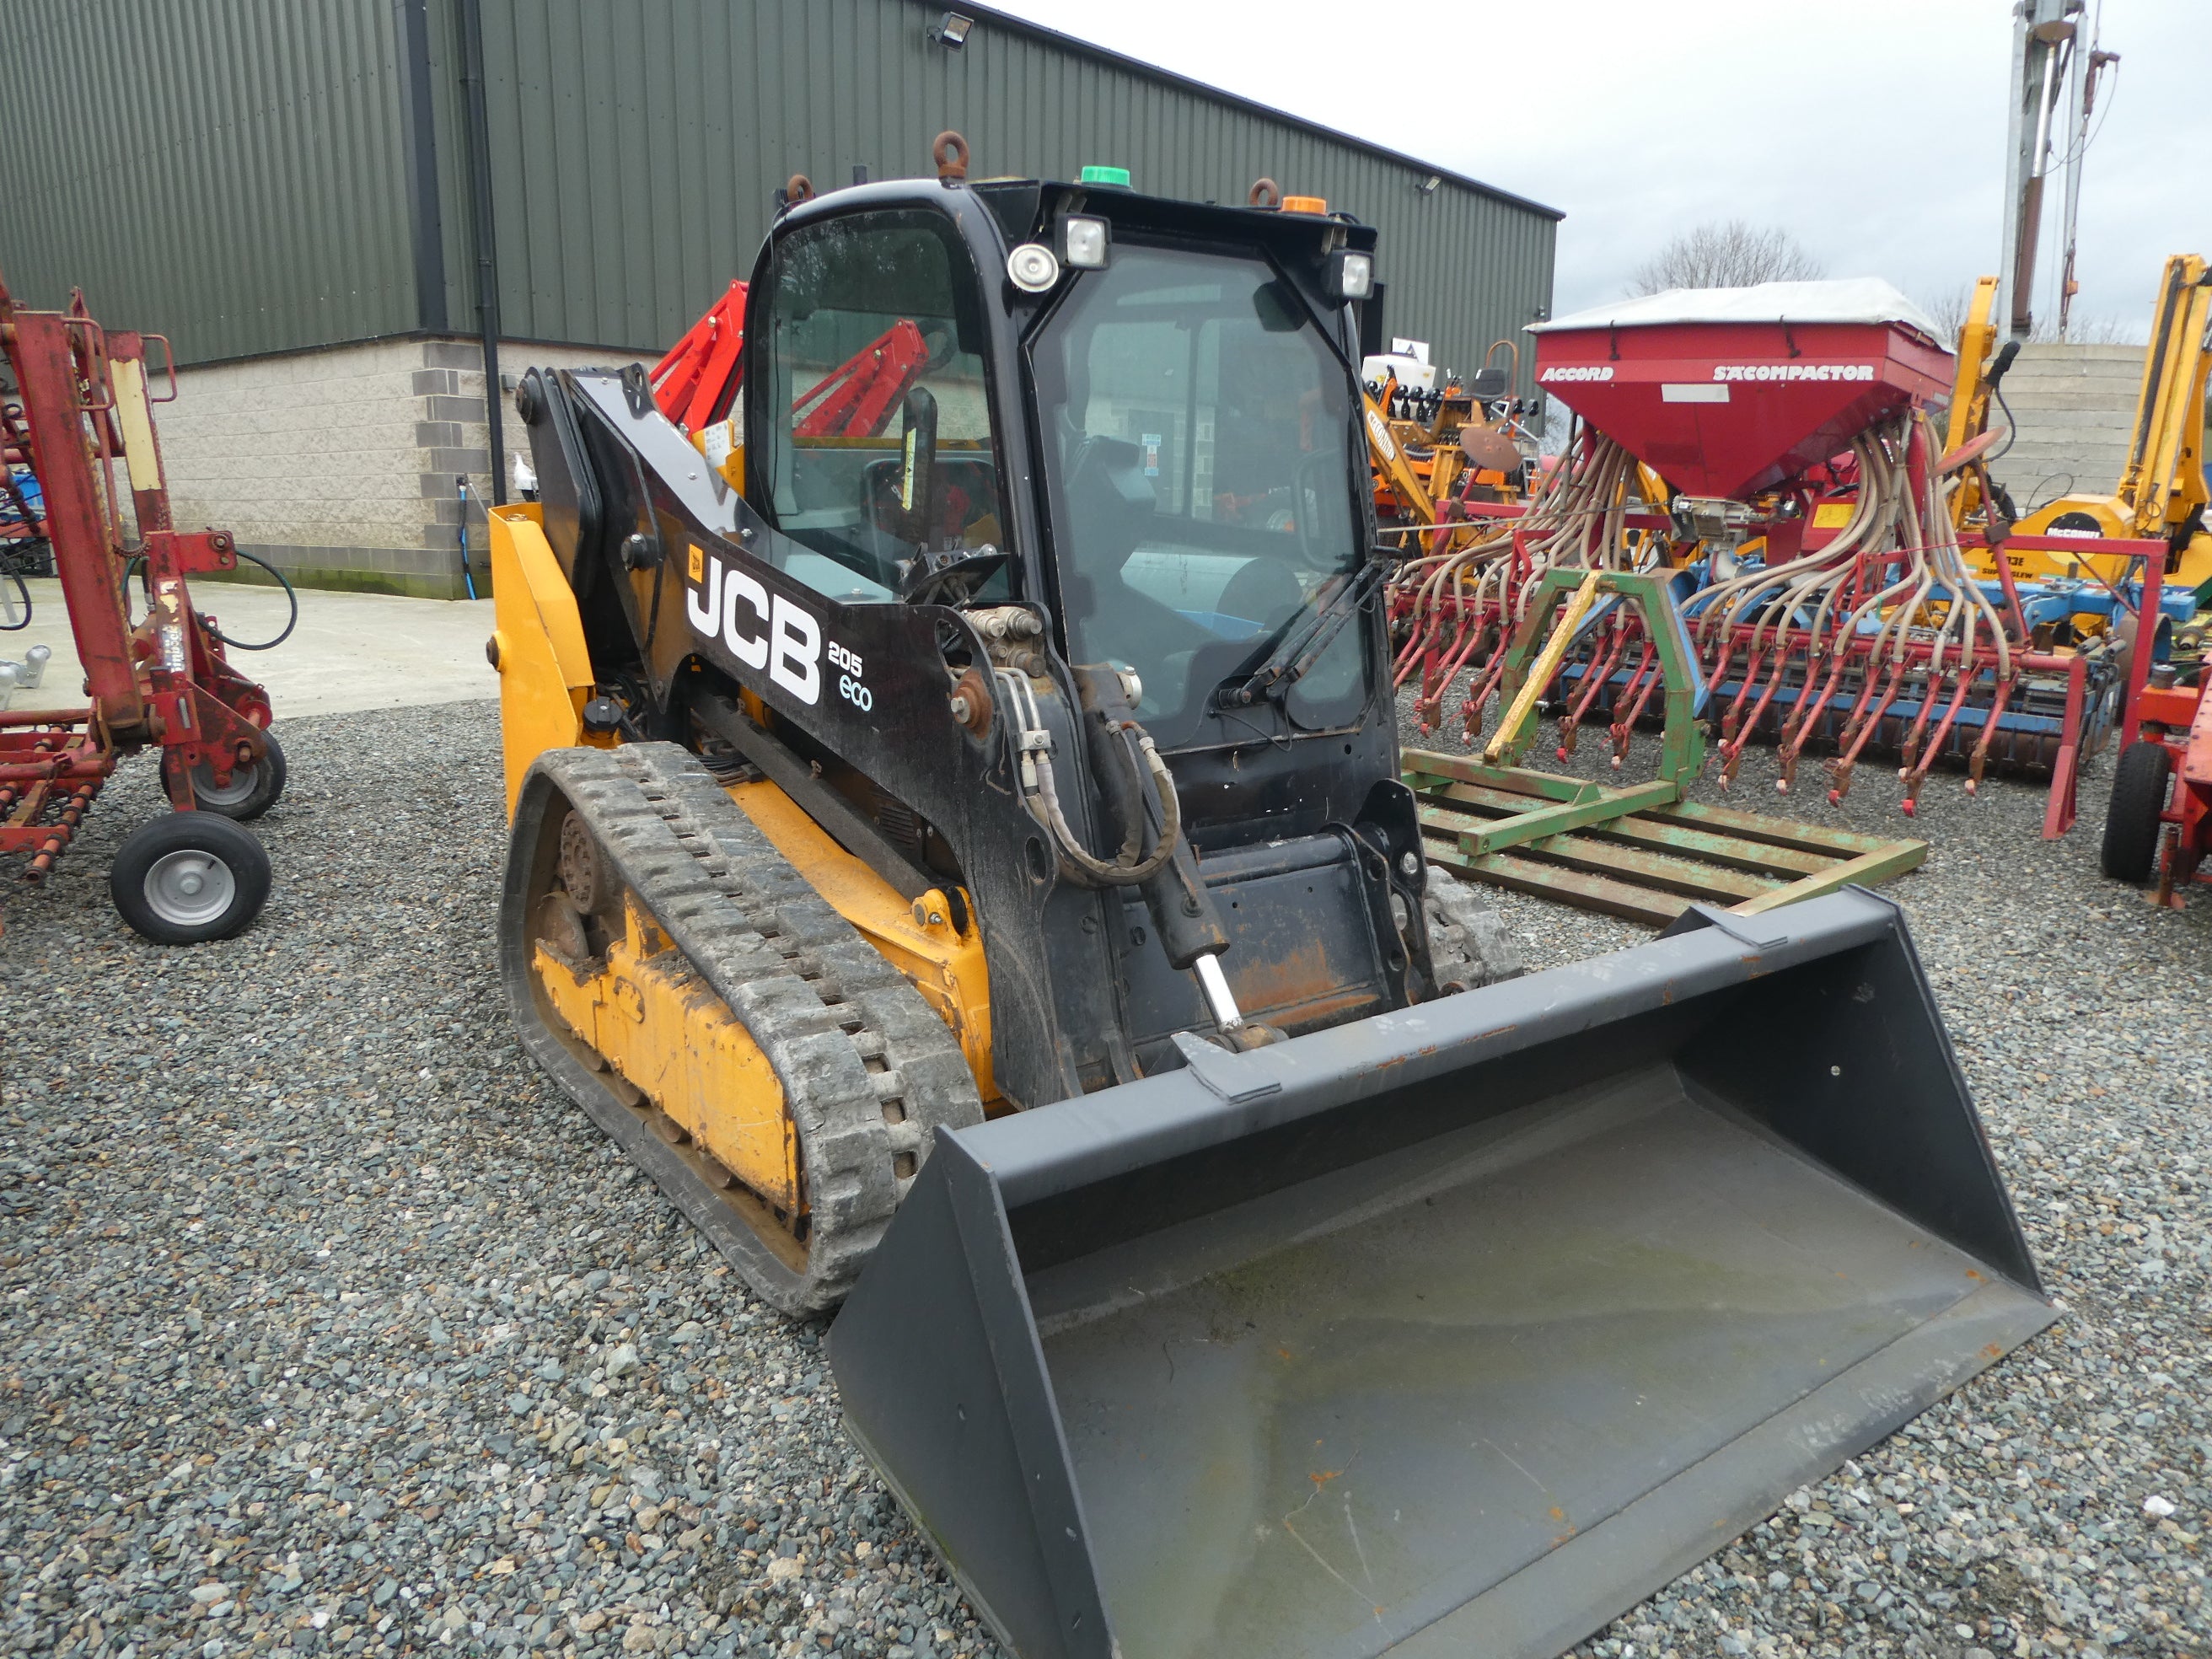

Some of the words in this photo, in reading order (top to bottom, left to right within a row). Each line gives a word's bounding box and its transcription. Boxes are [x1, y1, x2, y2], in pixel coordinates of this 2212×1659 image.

[1540, 368, 1613, 381] ACCORD
[688, 556, 821, 705] JCB
[828, 641, 862, 678] 205
[839, 674, 872, 711] eco
